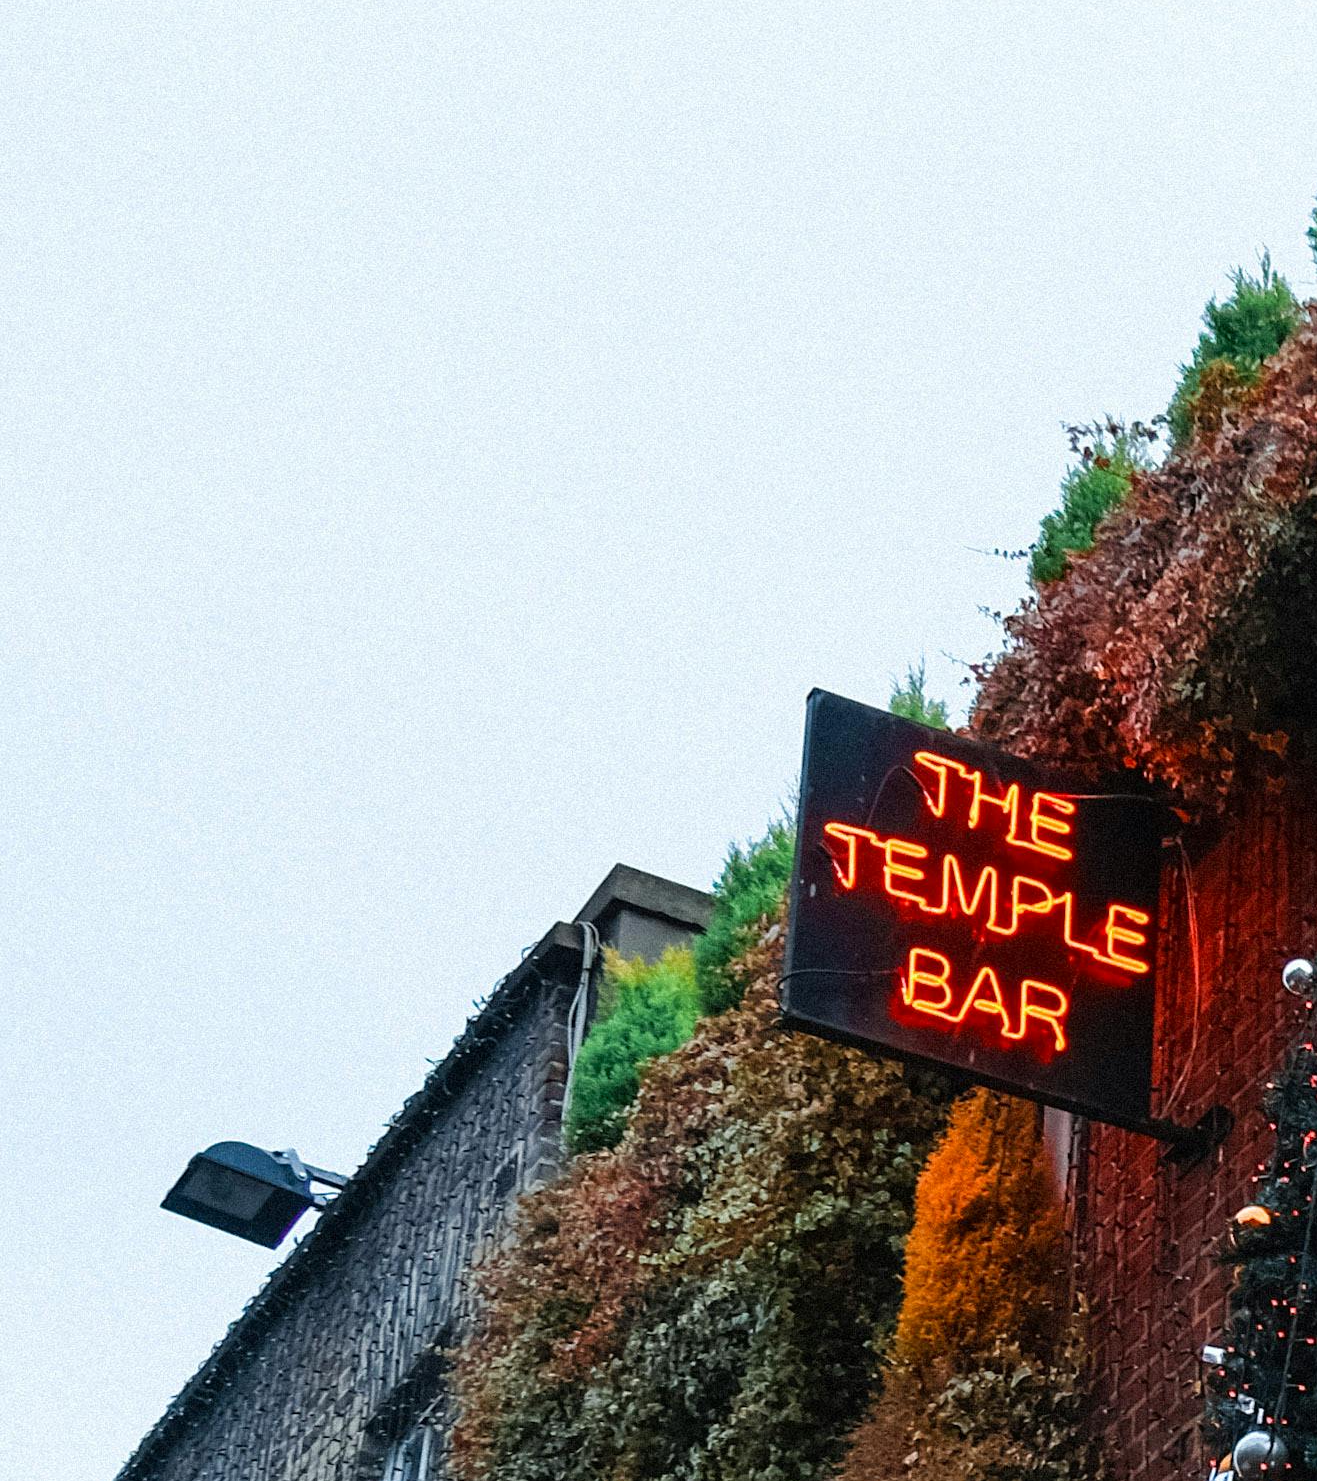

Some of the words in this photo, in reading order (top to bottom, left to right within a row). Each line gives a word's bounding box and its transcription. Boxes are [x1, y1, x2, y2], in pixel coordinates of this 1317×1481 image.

[915, 751, 1076, 861] THE
[825, 823, 1150, 973] TEMPLE
[903, 948, 1068, 1052] BAR
